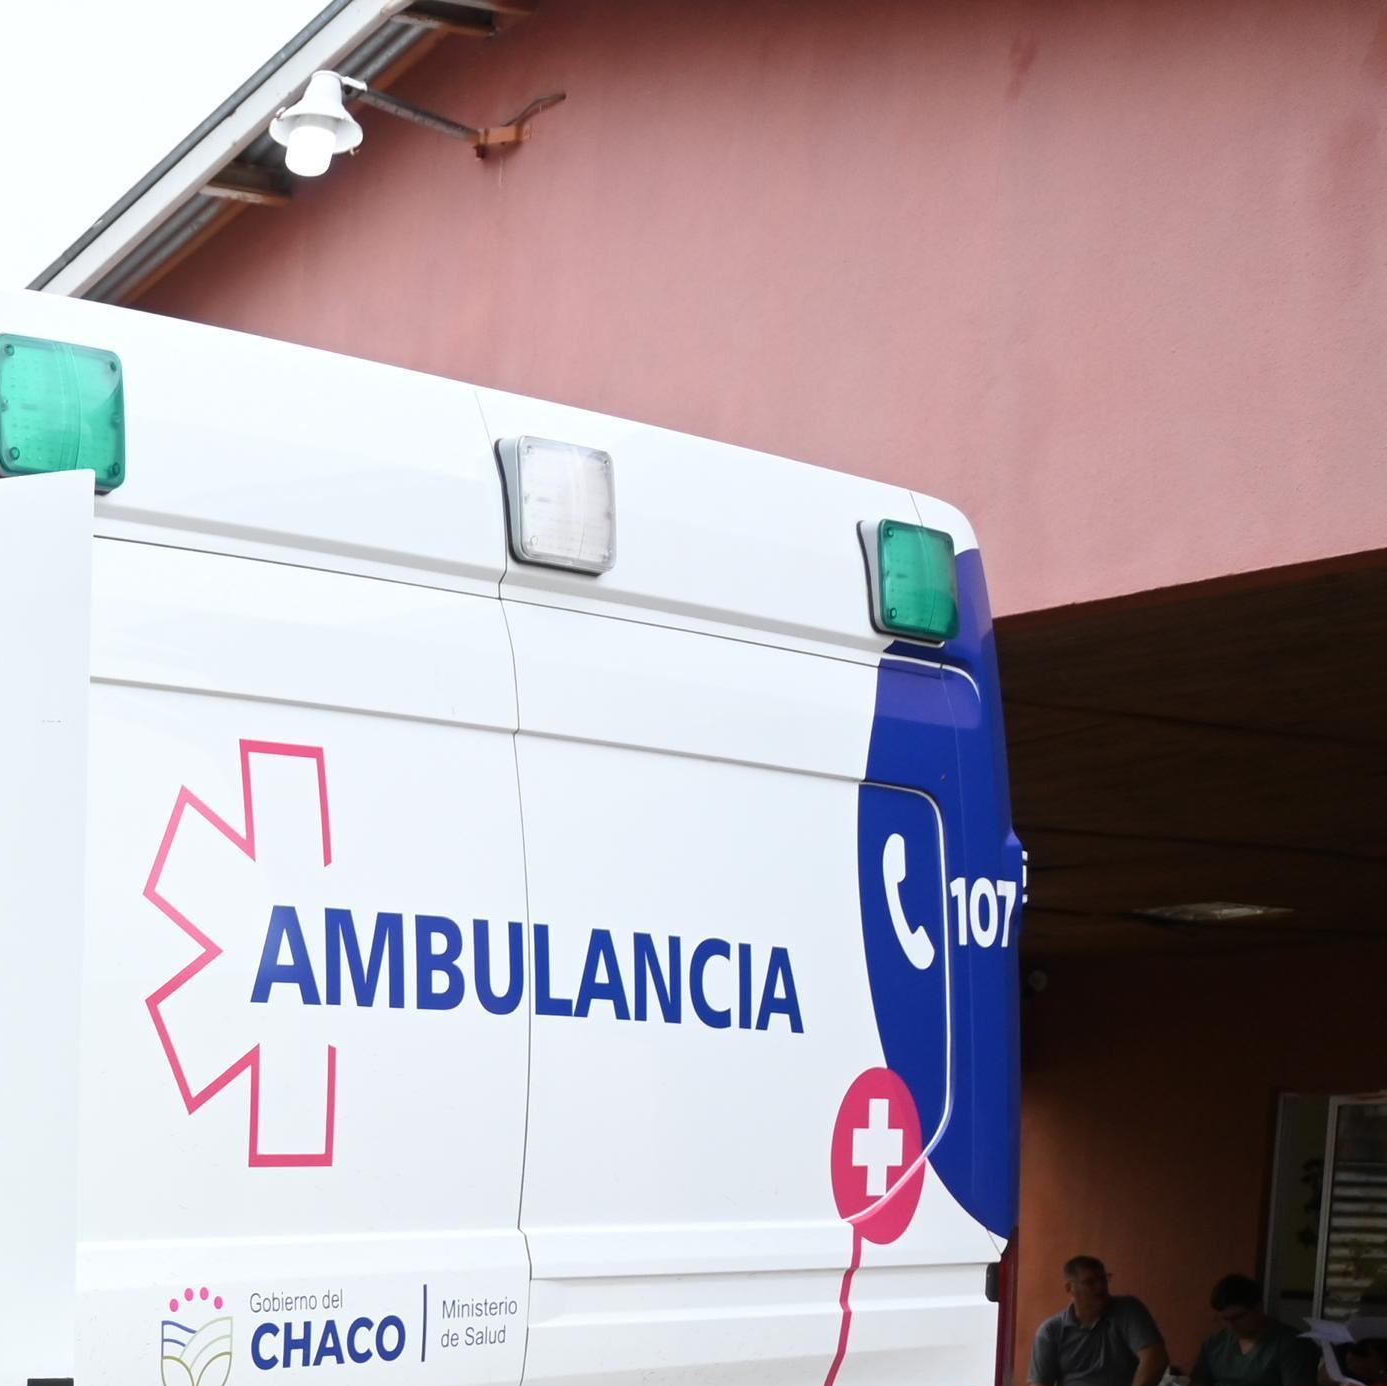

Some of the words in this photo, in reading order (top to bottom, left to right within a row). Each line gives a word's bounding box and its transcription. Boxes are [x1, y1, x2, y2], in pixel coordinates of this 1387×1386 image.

[950, 877, 1016, 948] 107
[250, 904, 805, 1034] AMBULANCIA
[249, 1290, 318, 1314] Gobierno
[322, 1288, 344, 1310] del
[441, 1297, 518, 1319] Ministerio
[250, 1314, 407, 1371] CHACO
[440, 1328, 460, 1348] de
[464, 1325, 507, 1347] Salud
